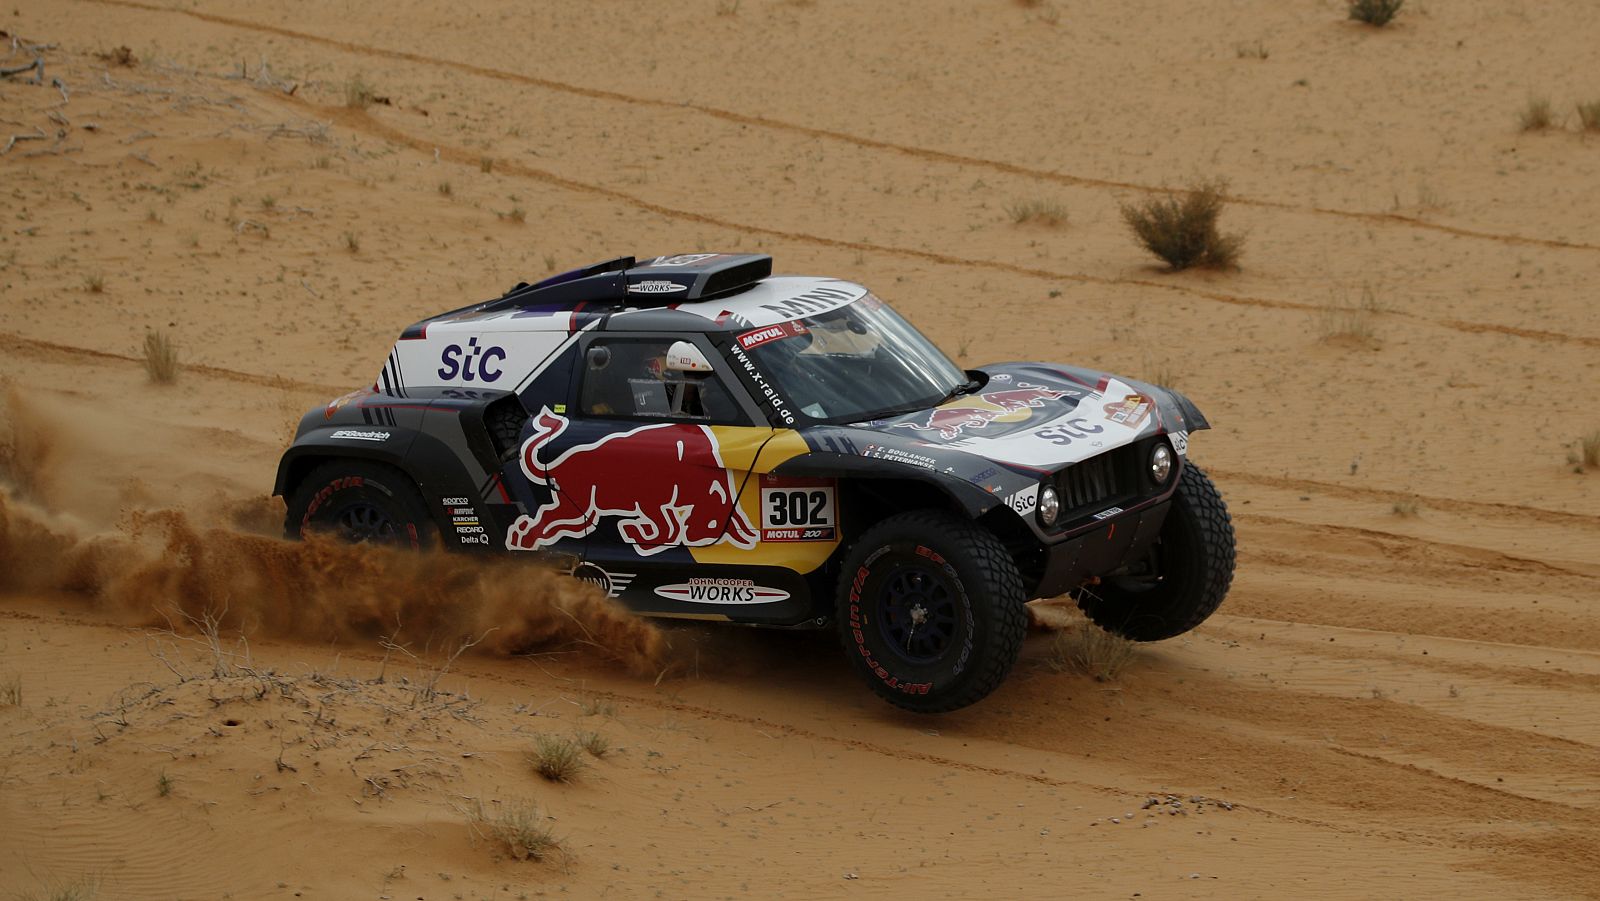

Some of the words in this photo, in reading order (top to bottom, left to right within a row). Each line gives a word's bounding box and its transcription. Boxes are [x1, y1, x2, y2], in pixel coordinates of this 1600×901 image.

[640, 284, 671, 292] WORKS
[760, 288, 855, 318] MINI
[742, 324, 783, 347] MOTUL
[730, 344, 795, 425] www.x-raid.de
[769, 491, 828, 526] 302
[456, 526, 484, 534] RECARO
[766, 530, 800, 539] MOTUL
[802, 530, 822, 538] 300
[461, 536, 479, 544] Delta
[688, 578, 715, 586] JOHN
[717, 579, 753, 587] COOPER
[689, 586, 754, 602] WORKS
